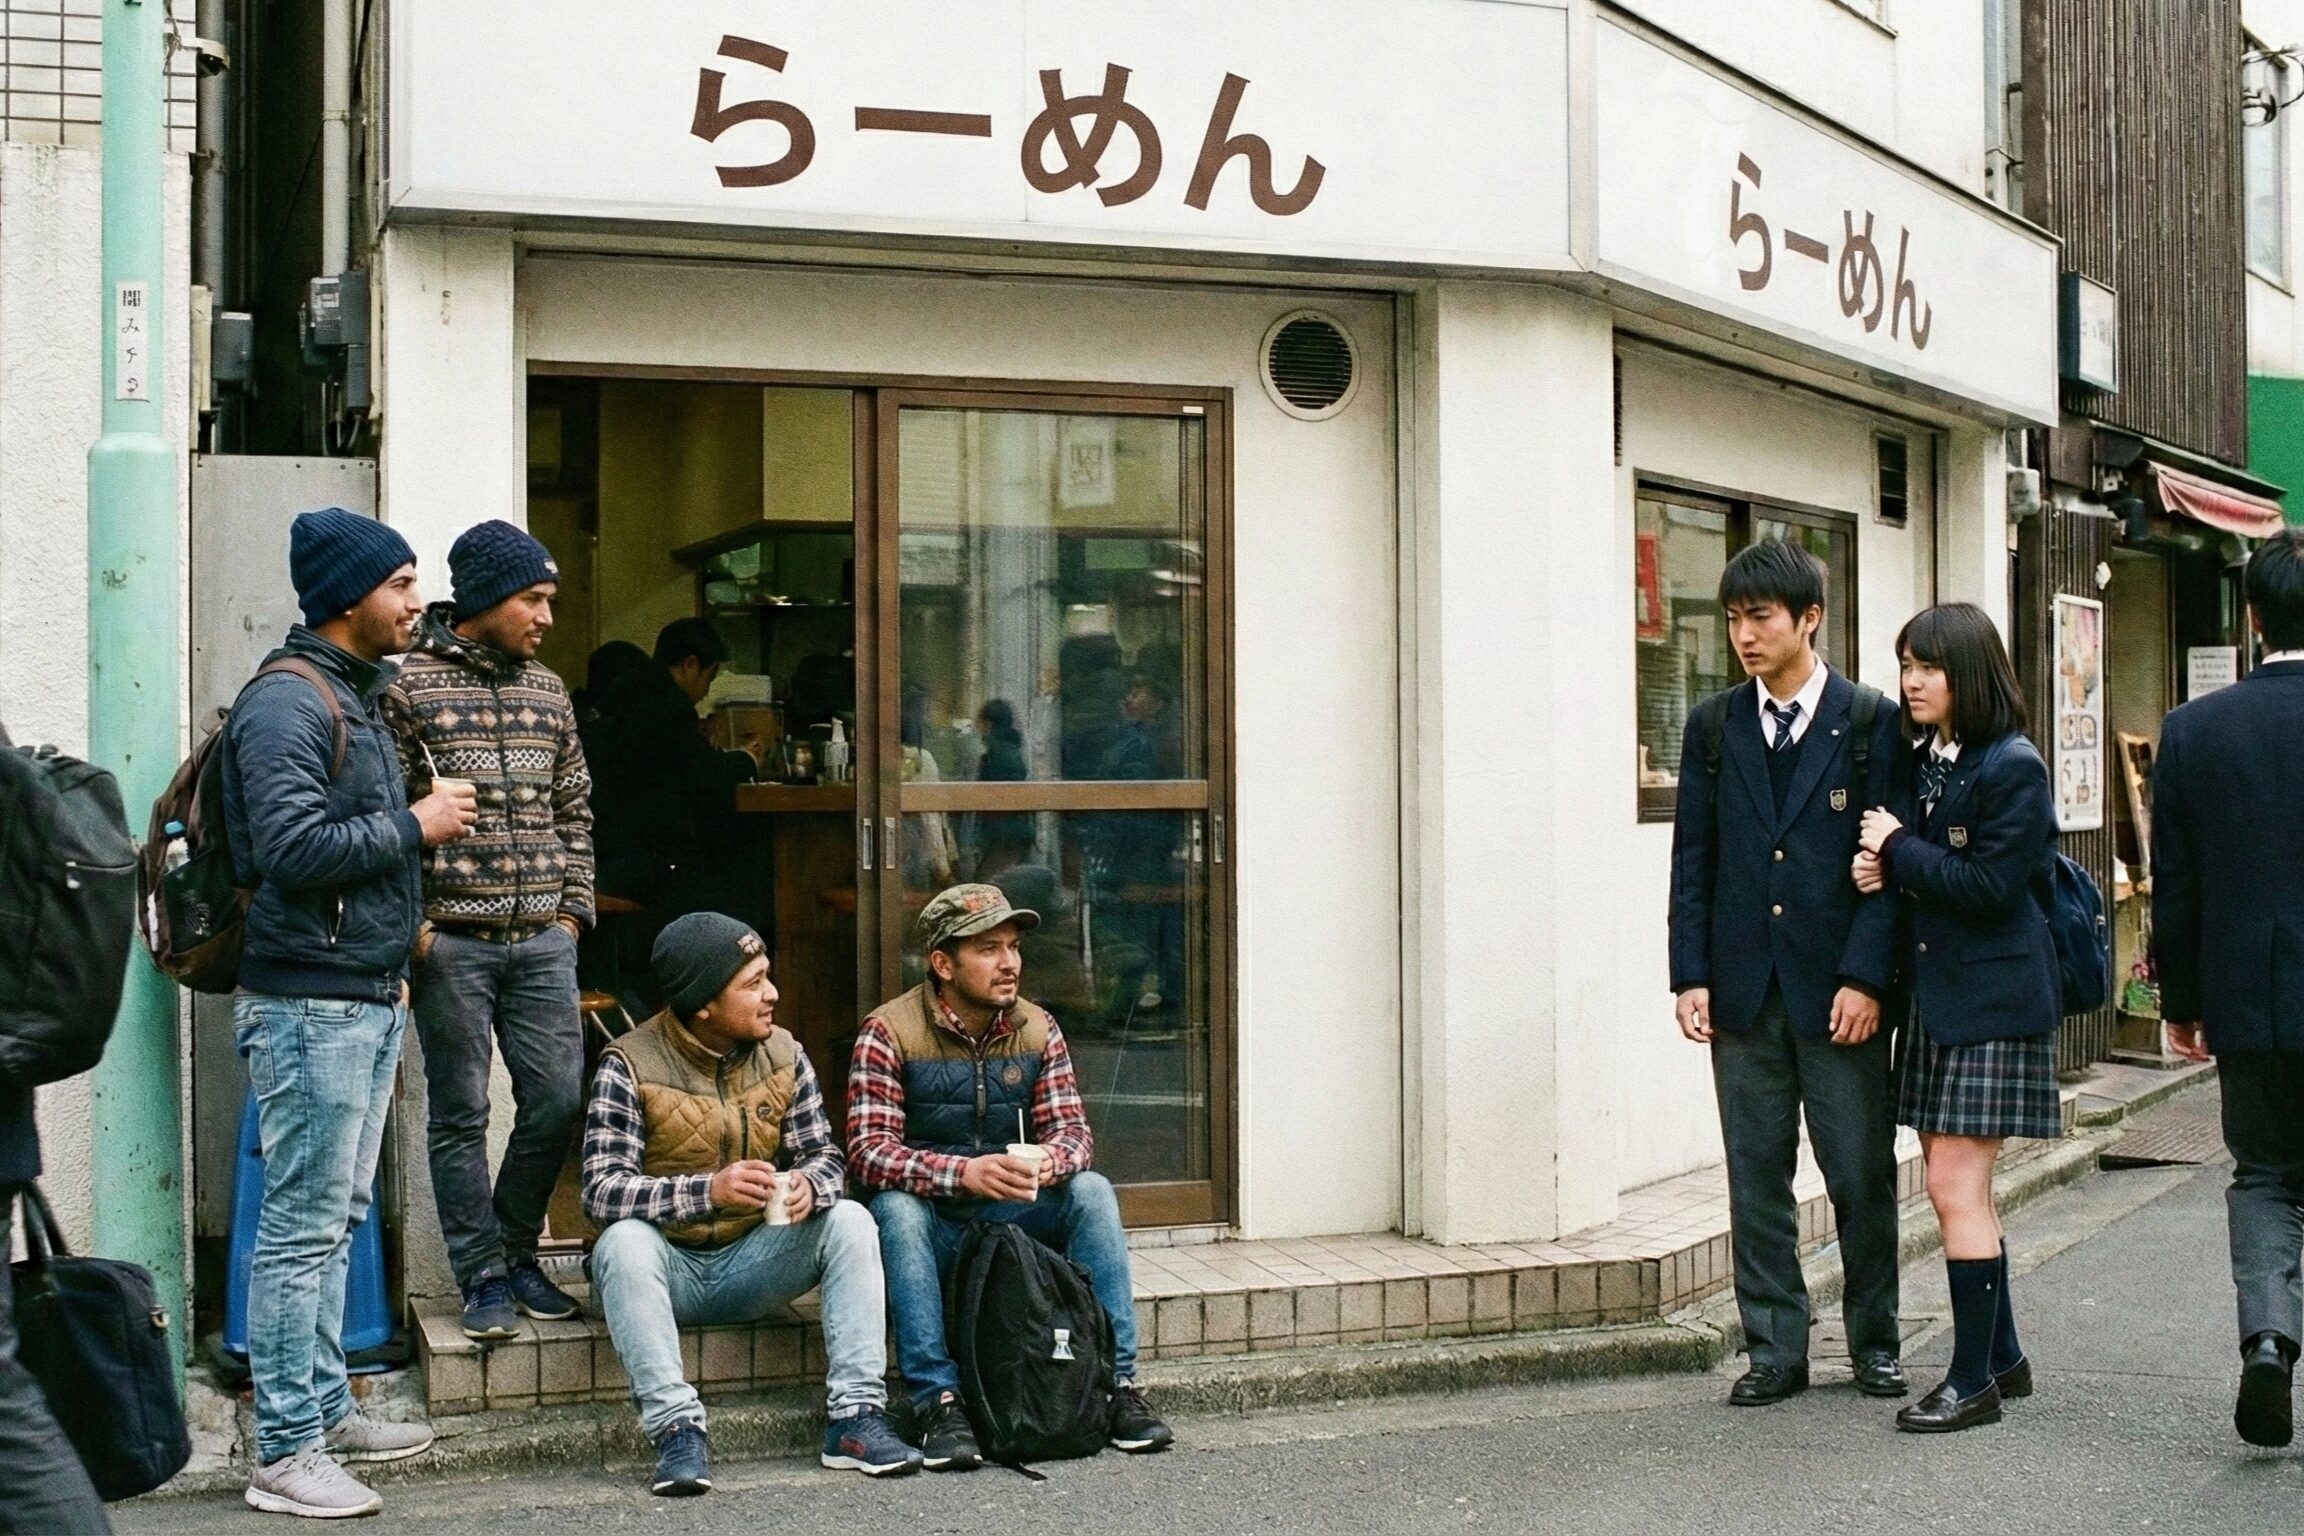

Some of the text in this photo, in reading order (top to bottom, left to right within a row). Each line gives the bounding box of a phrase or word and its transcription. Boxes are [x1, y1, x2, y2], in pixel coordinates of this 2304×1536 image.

[691, 35, 1326, 215] らーめん
[1729, 151, 1932, 350] らーめん
